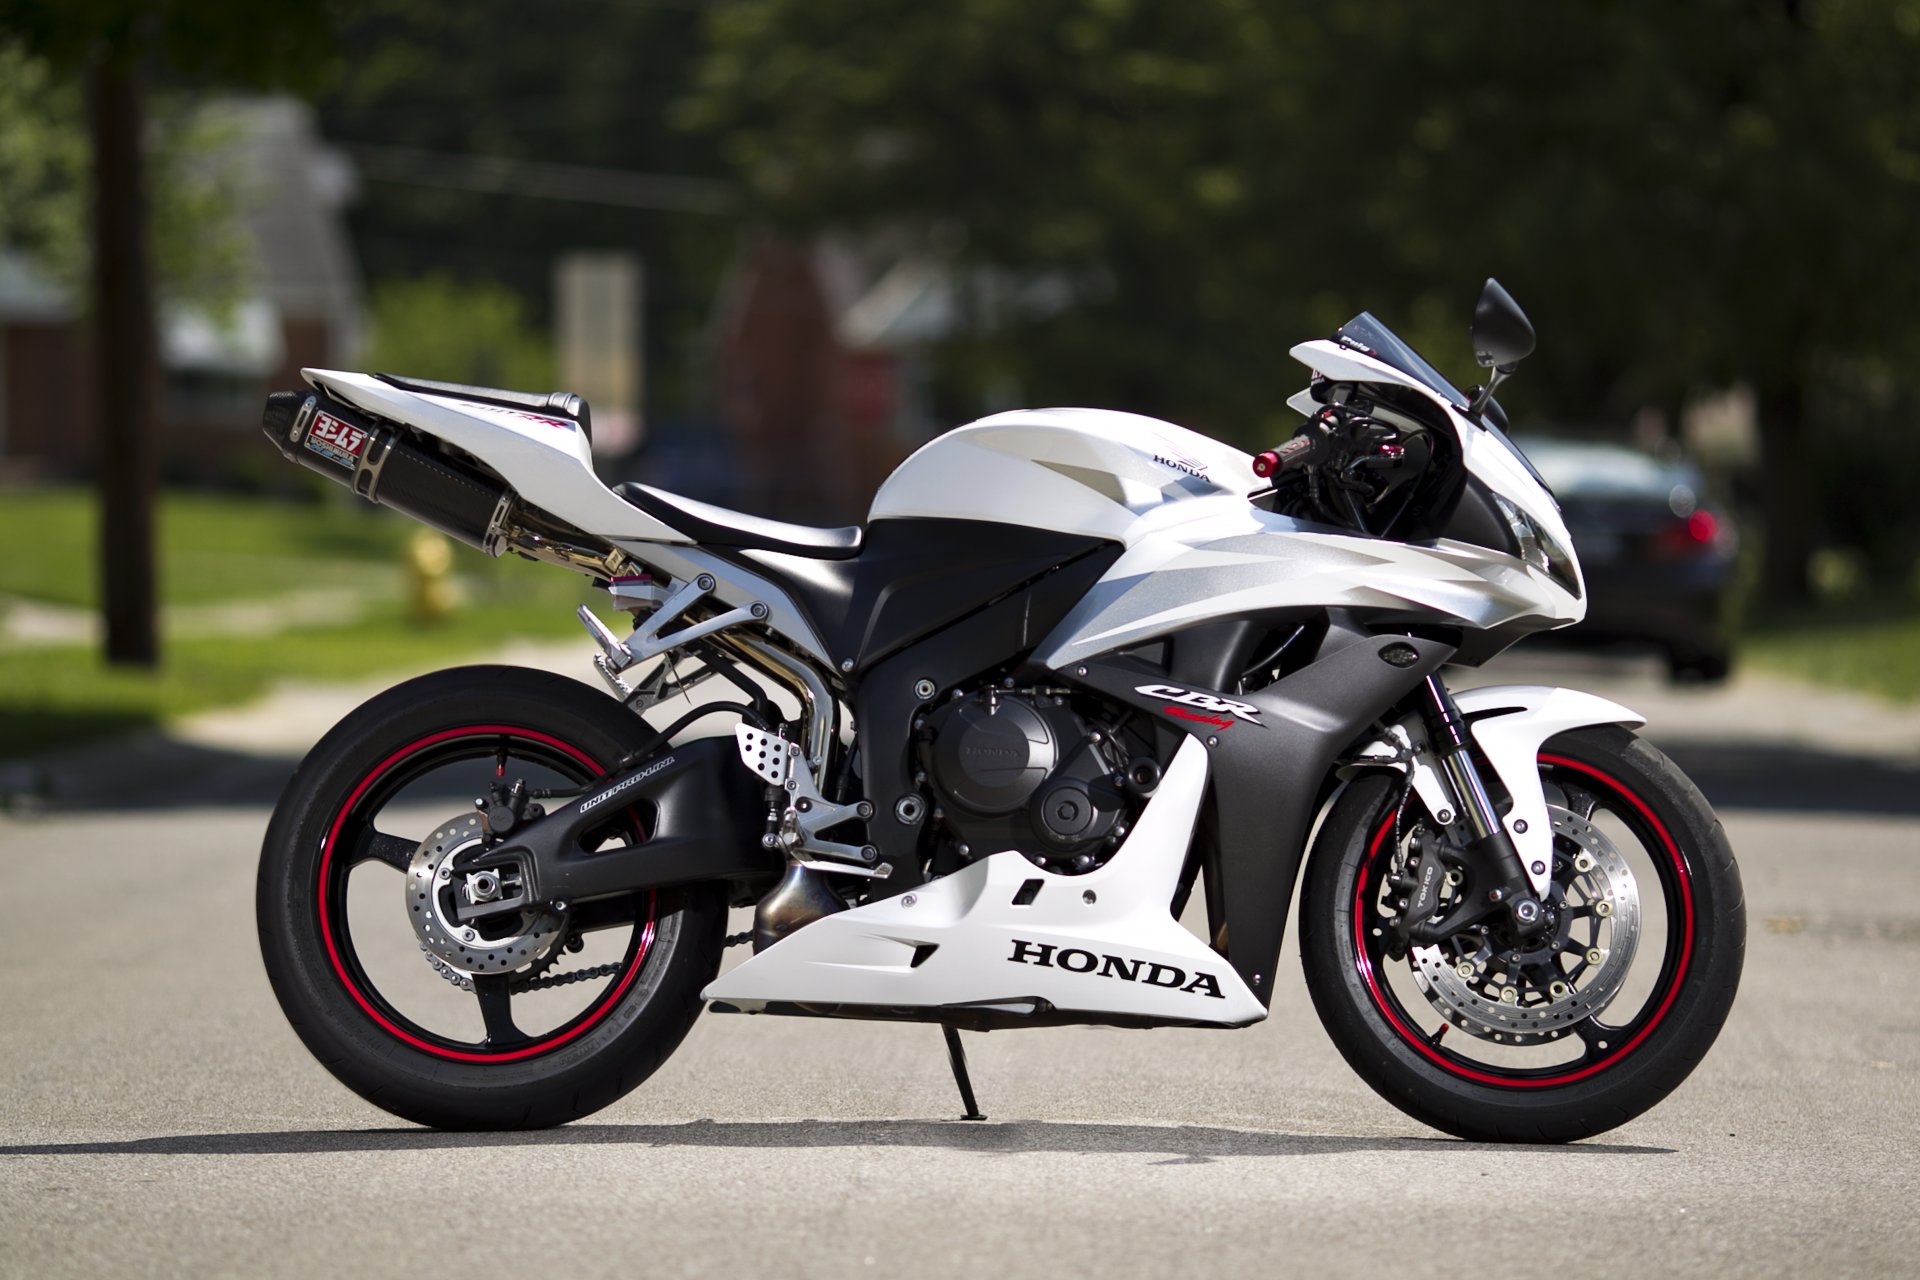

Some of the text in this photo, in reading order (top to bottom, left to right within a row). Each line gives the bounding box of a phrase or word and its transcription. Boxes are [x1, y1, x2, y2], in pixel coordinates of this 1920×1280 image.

[315, 415, 362, 451] ヨシムラ
[1153, 454, 1212, 483] HONDA
[1134, 684, 1263, 725] CBR
[1417, 866, 1433, 908] TOKICO
[1007, 939, 1226, 999] HONDA
